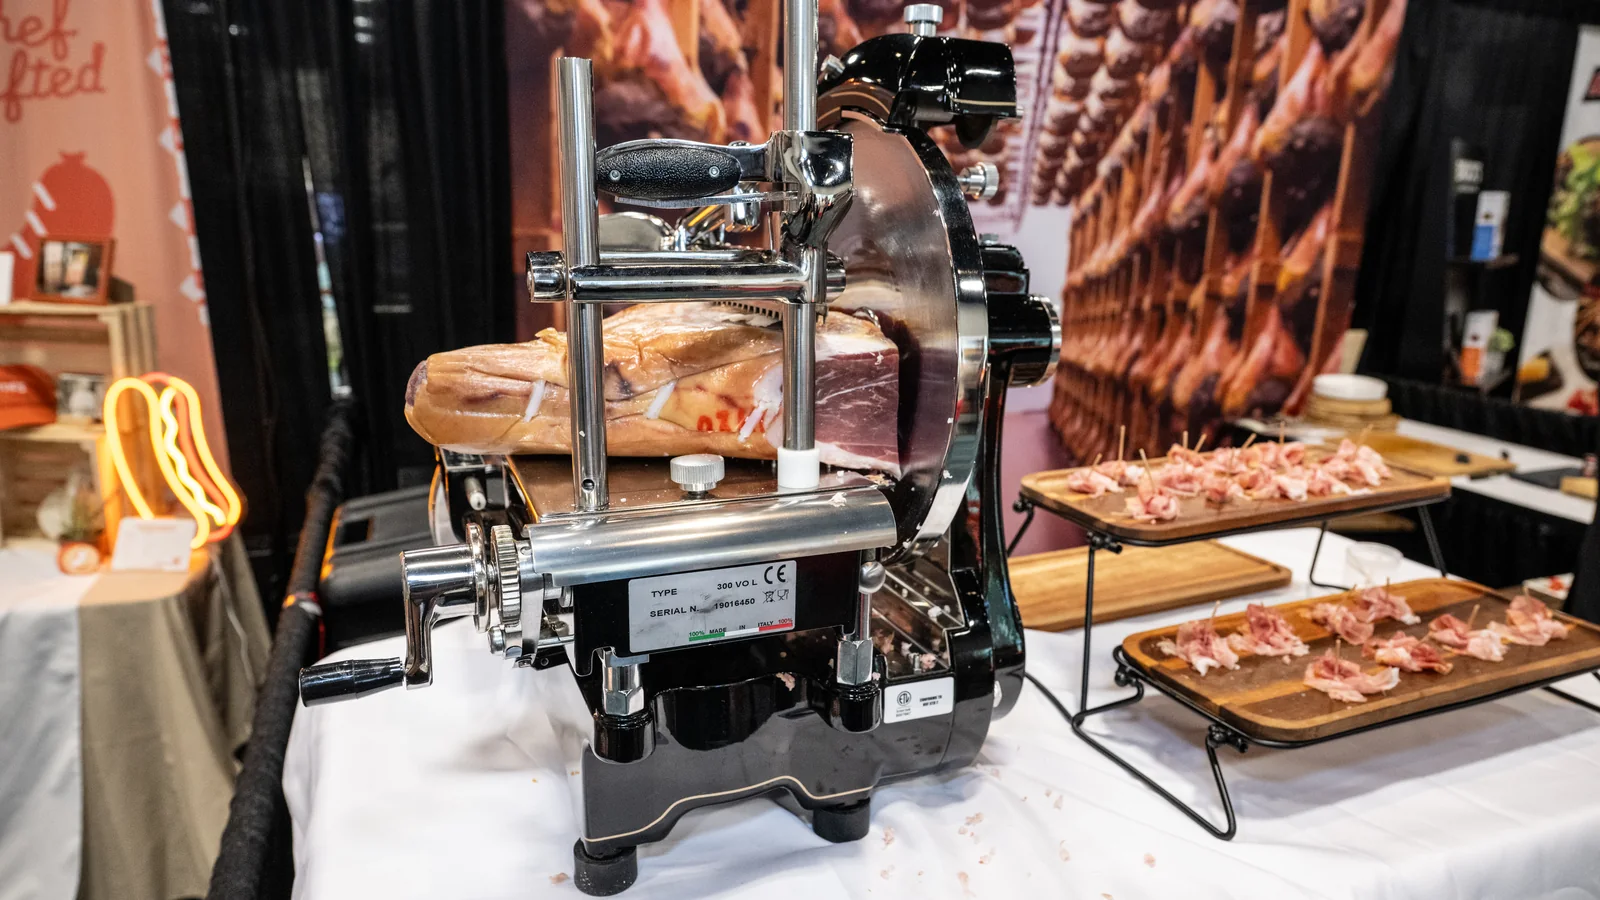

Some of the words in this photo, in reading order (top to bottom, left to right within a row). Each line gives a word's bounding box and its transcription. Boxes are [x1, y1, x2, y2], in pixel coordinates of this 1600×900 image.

[717, 582, 733, 590] 300
[651, 588, 678, 598] TYPE
[714, 598, 755, 610] 19016450
[650, 607, 687, 618] SERIAL
[690, 605, 700, 613] N.
